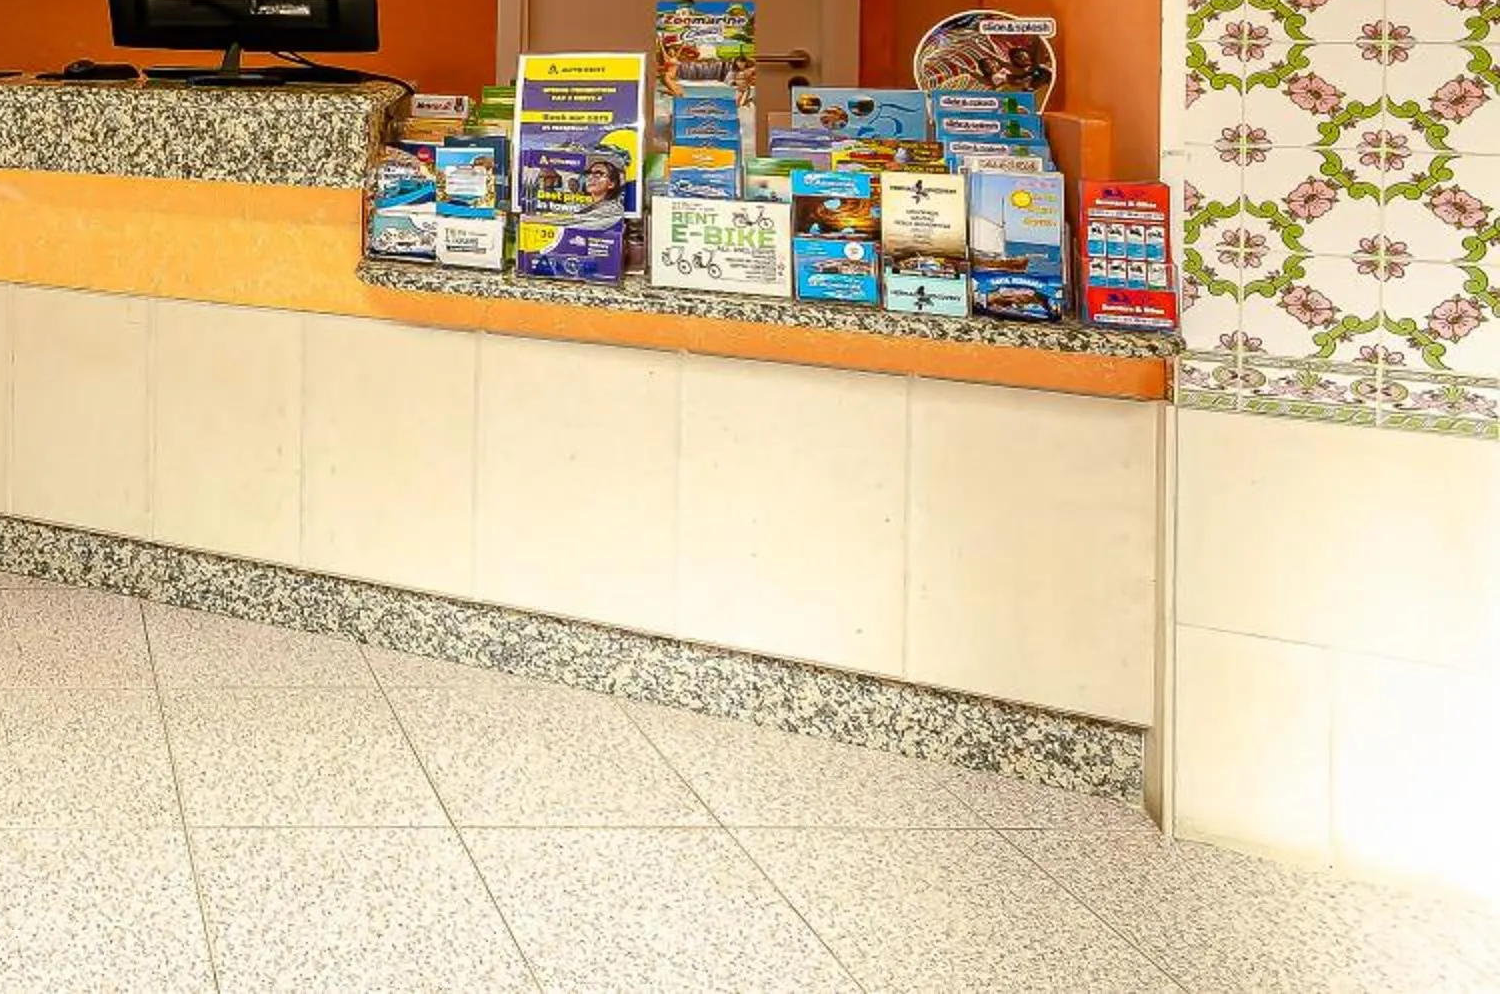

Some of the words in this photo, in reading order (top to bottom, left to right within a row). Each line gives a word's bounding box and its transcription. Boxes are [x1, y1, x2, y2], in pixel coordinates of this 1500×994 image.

[664, 12, 747, 26] Zoomarine
[537, 188, 562, 201] Best
[671, 210, 718, 225] RENT
[671, 223, 777, 249] E-BIKE
